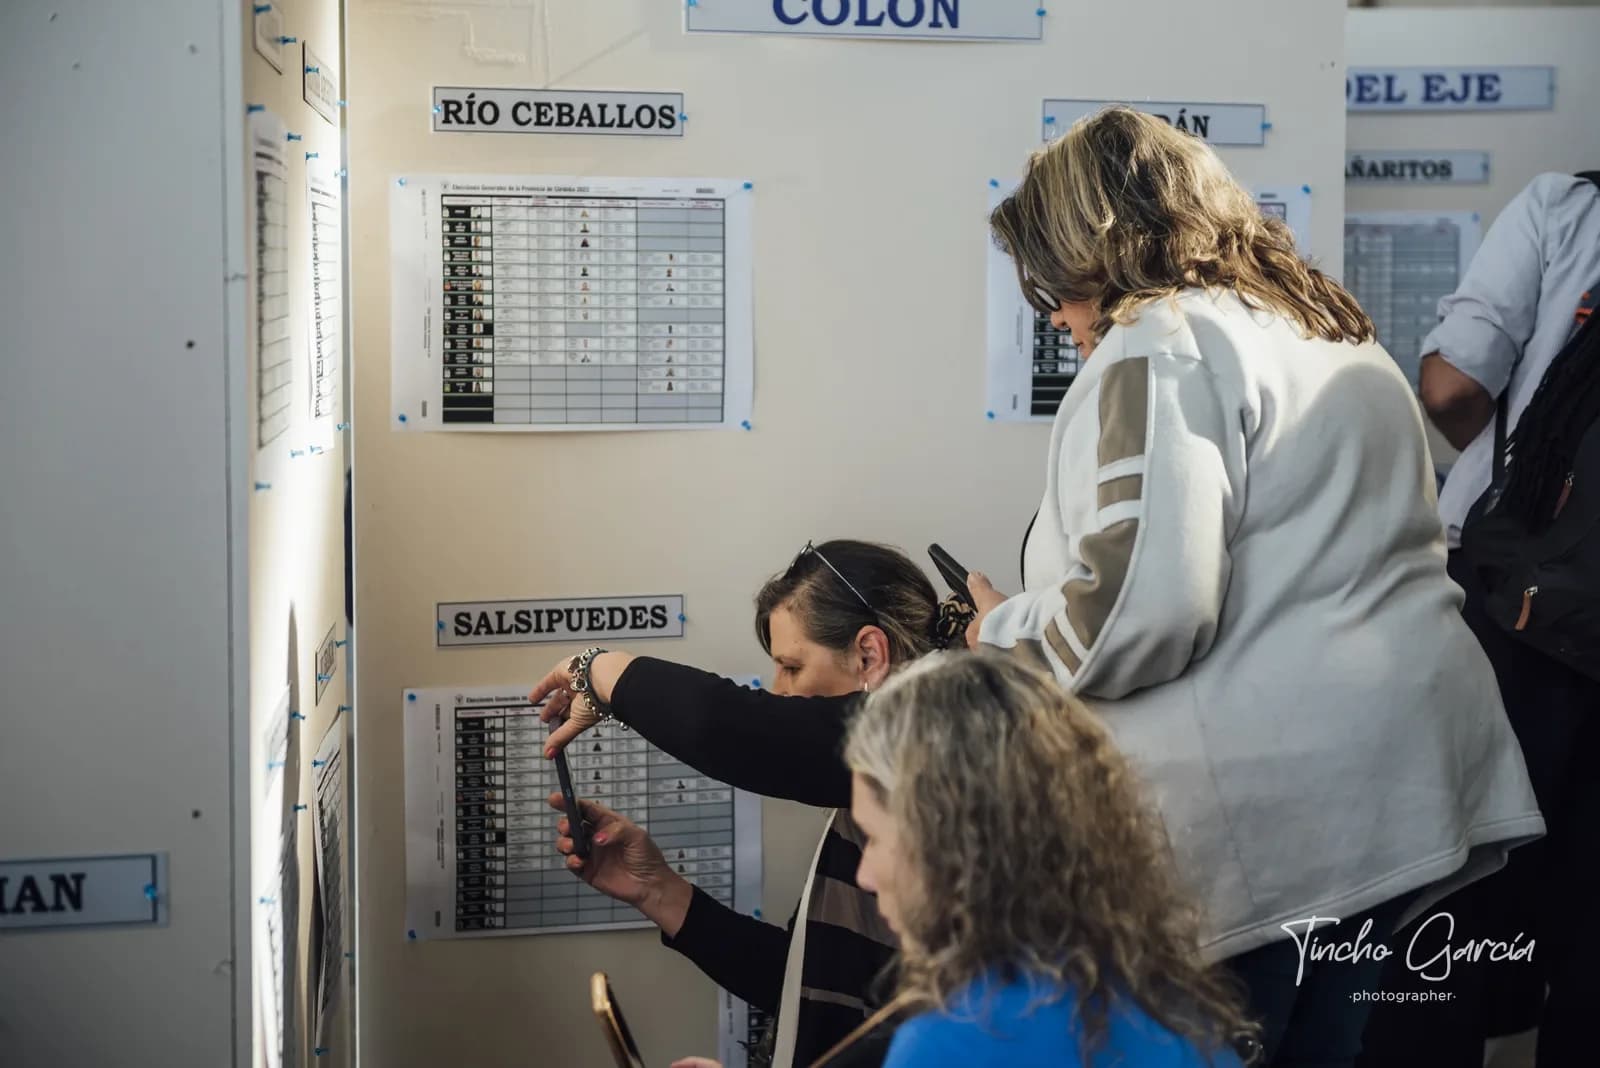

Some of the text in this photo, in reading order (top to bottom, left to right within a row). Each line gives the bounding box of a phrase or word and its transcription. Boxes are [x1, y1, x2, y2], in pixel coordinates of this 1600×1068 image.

[1346, 72, 1502, 104] EL EJE
[441, 92, 677, 130] RÍO CEBALLOS
[1344, 154, 1452, 178] ÑARITOS
[453, 604, 669, 637] SALSIPUEDES
